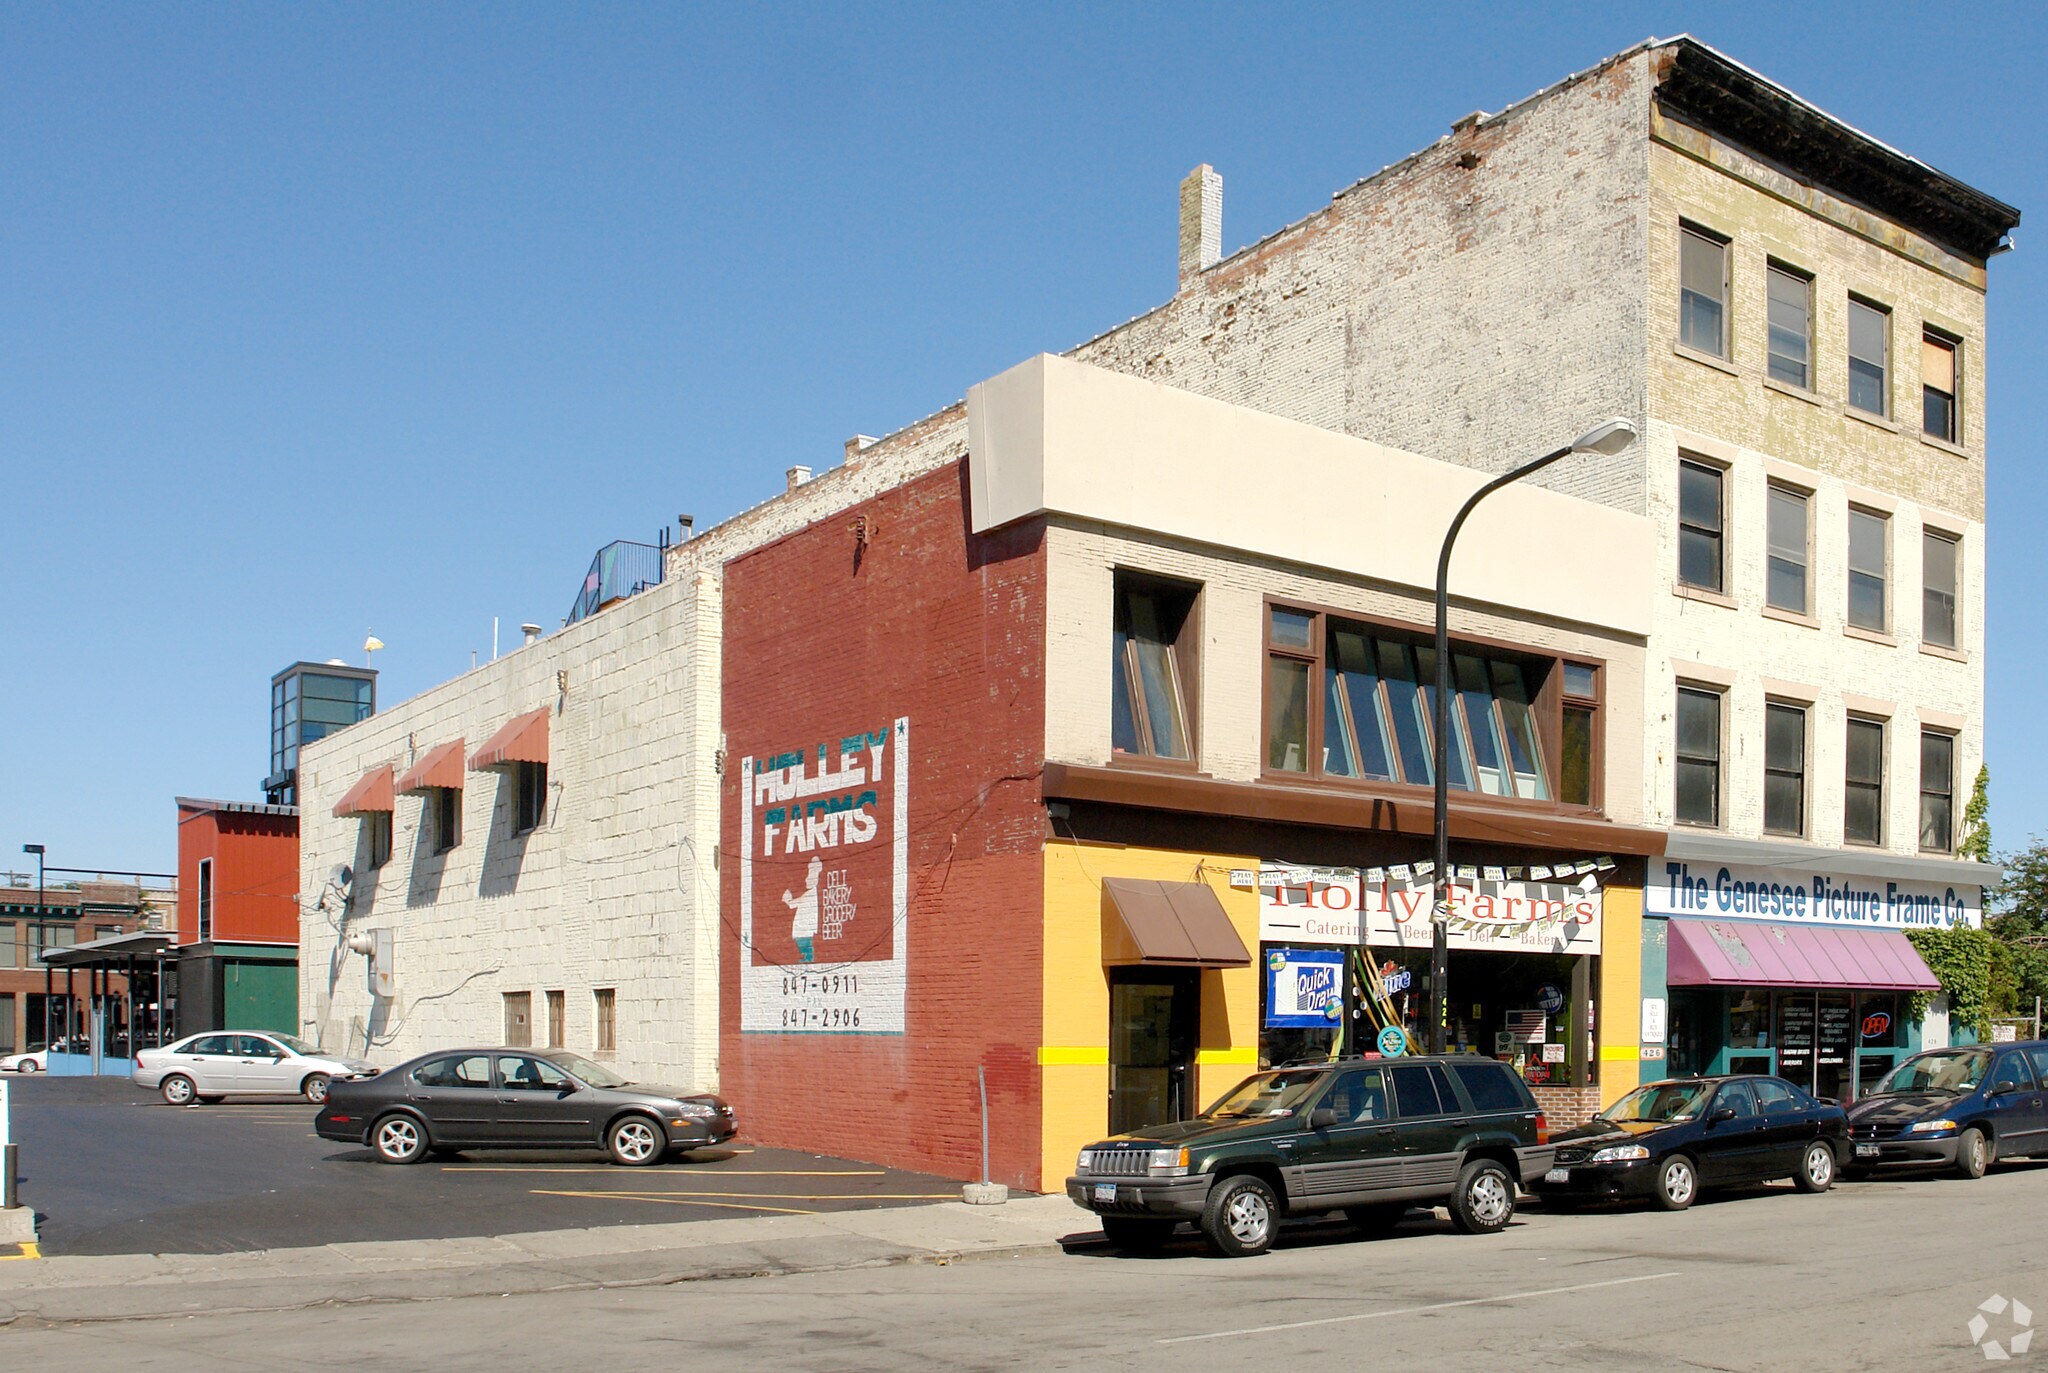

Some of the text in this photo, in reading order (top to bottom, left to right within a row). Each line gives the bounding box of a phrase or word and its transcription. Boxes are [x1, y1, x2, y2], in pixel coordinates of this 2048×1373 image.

[755, 727, 889, 806] HOLLEY
[764, 790, 877, 857] FARMS
[826, 869, 848, 888] DELI
[822, 886, 852, 906] BAKERY
[1269, 876, 1594, 925] Holly Farms
[1666, 862, 1969, 929] The Genesee Picture Frame Co.
[822, 903, 857, 922] GROCERY
[822, 922, 843, 940] BEER
[1306, 919, 1370, 939] Catering
[1521, 931, 1563, 947] Bakery
[782, 974, 857, 996] 847-0911
[1298, 966, 1331, 997] Quick
[782, 1008, 860, 1027] 847-2906
[1861, 1017, 1888, 1034] OPEN
[1643, 1049, 1661, 1057] 426
